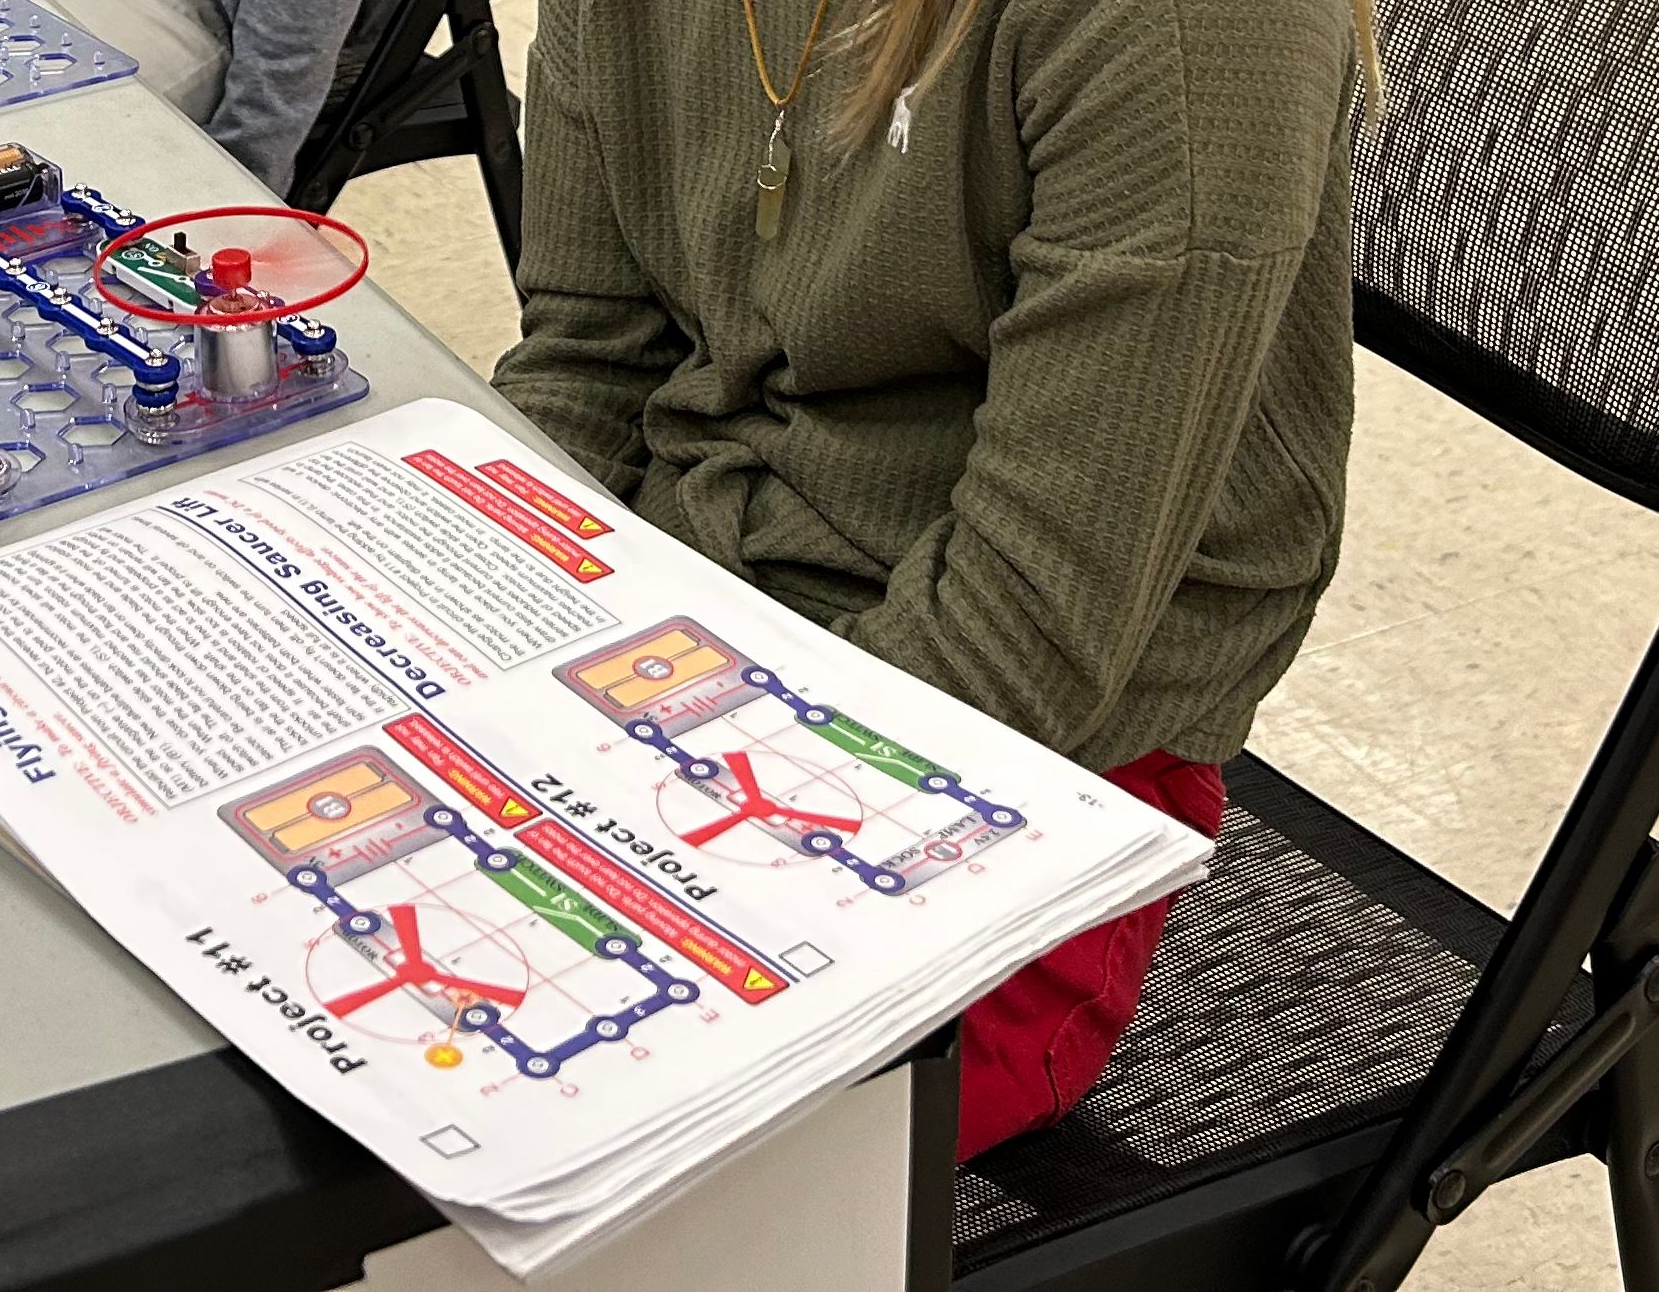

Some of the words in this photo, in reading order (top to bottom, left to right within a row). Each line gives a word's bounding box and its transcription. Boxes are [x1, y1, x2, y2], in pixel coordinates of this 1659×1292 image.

[172, 498, 219, 520] Lift
[216, 519, 302, 579] Saucer
[300, 580, 446, 699] Decreasing
[389, 620, 402, 630] To
[408, 636, 471, 685] OBJECTIVE:
[639, 658, 669, 677] B1
[58, 744, 72, 756] To
[75, 763, 138, 823] OBJECTIVE:
[314, 795, 348, 816] B1
[532, 774, 597, 817] #12
[595, 819, 717, 900] Project
[186, 928, 252, 974] #11
[247, 977, 367, 1074] Project
